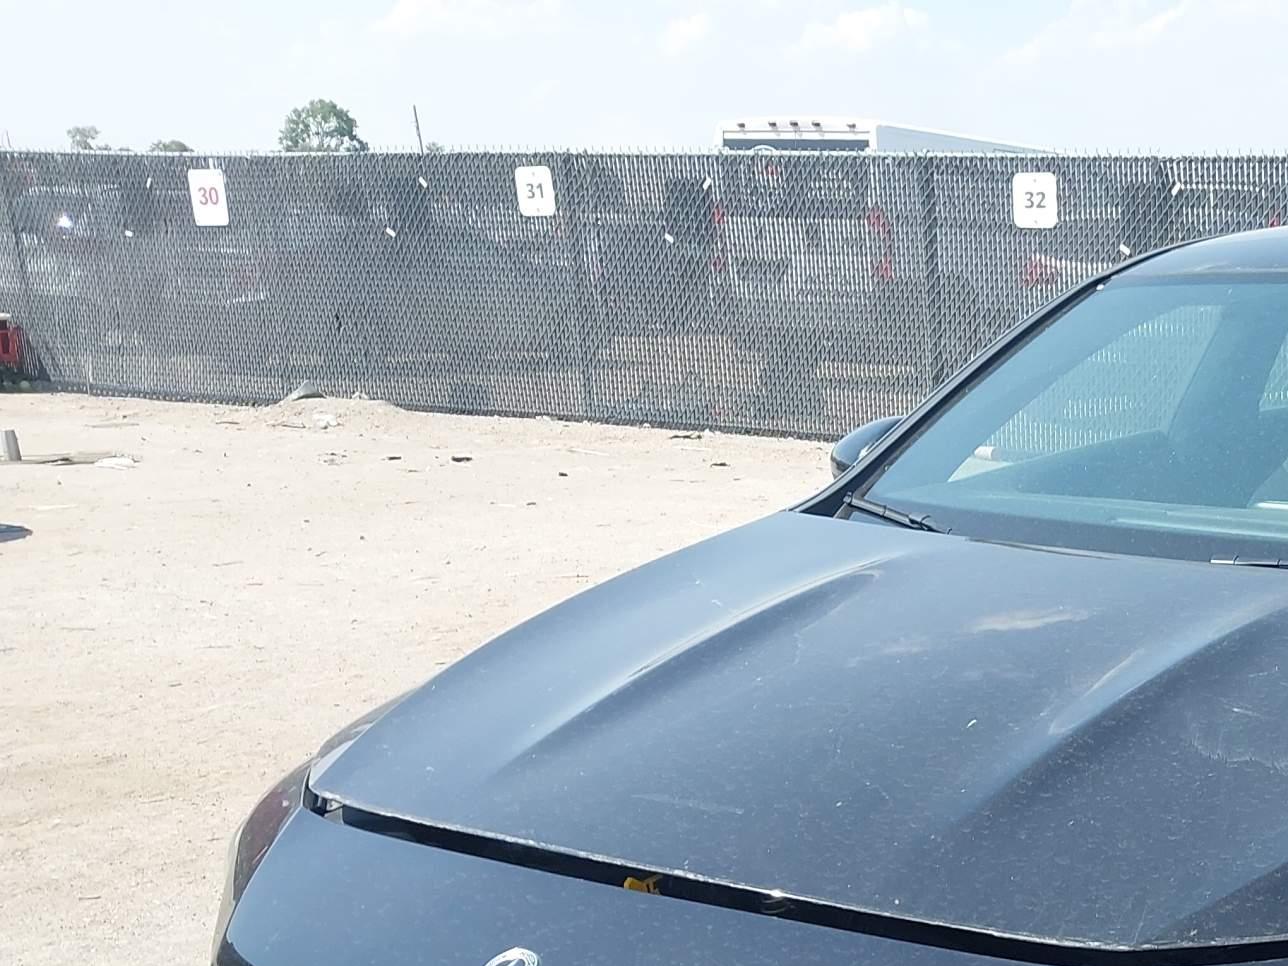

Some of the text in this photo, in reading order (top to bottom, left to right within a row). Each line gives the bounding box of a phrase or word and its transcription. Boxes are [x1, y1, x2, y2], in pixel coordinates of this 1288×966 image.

[197, 186, 220, 206] 30
[525, 182, 545, 199] 31
[1023, 191, 1047, 209] 32
